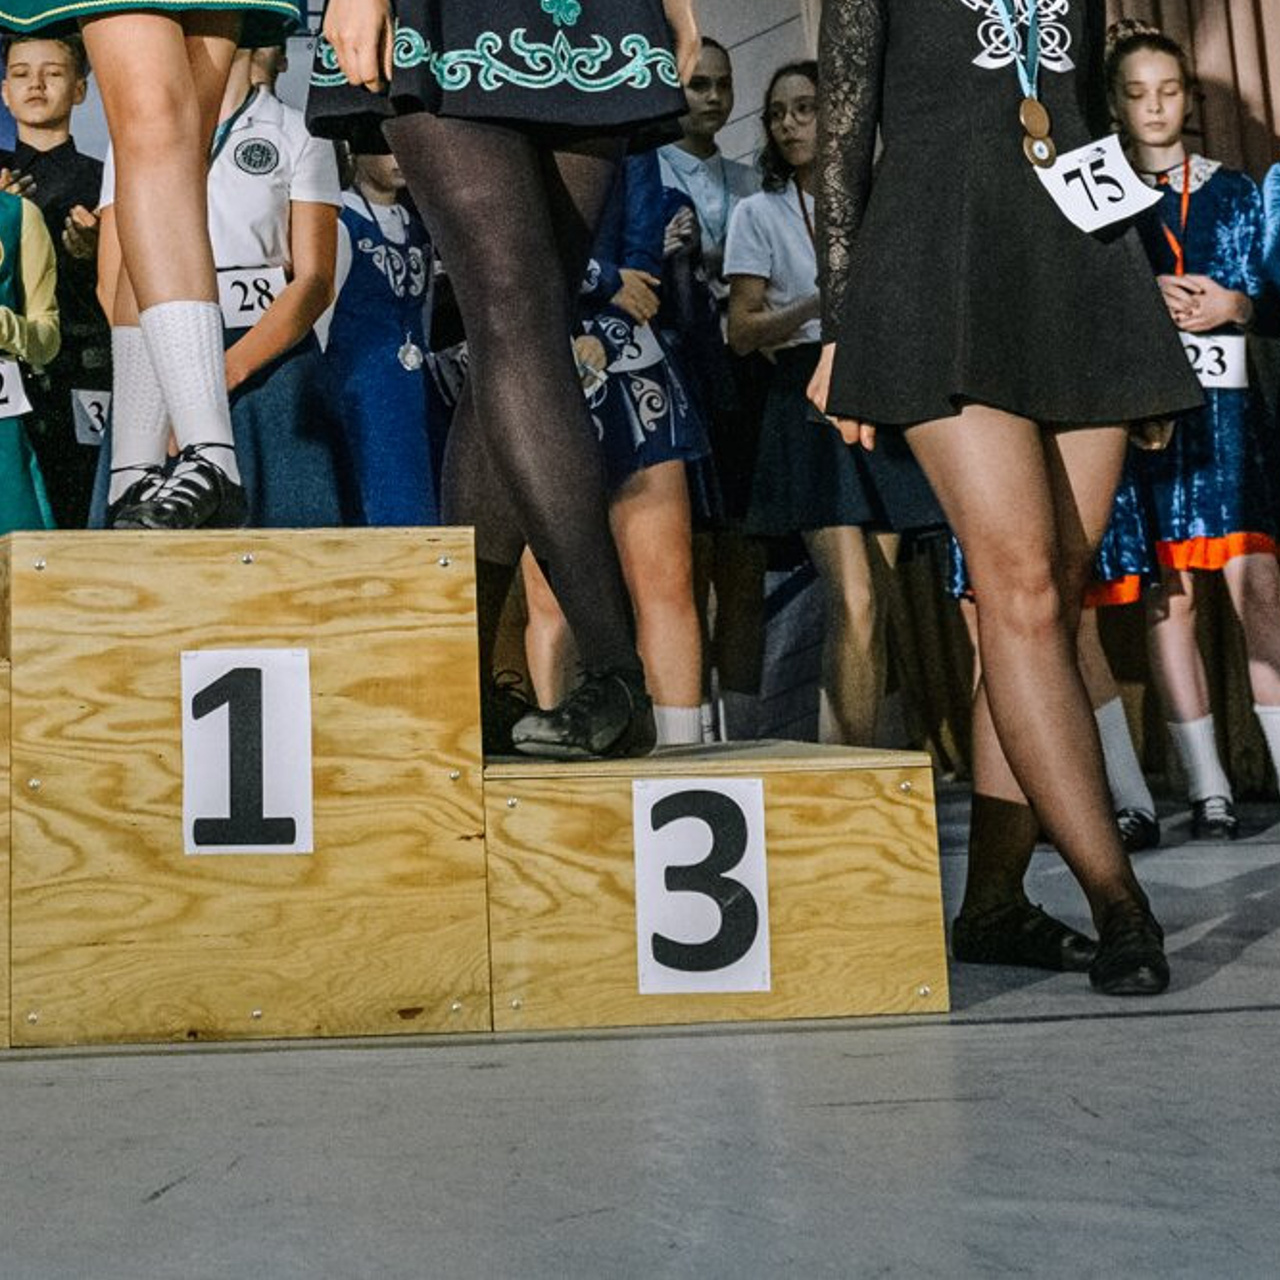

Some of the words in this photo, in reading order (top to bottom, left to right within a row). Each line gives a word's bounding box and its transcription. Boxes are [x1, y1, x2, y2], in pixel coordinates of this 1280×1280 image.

[1062, 158, 1125, 211] 75
[231, 278, 275, 311] 28
[1184, 344, 1227, 377] 23
[191, 666, 297, 846] 1
[650, 789, 760, 972] 3
